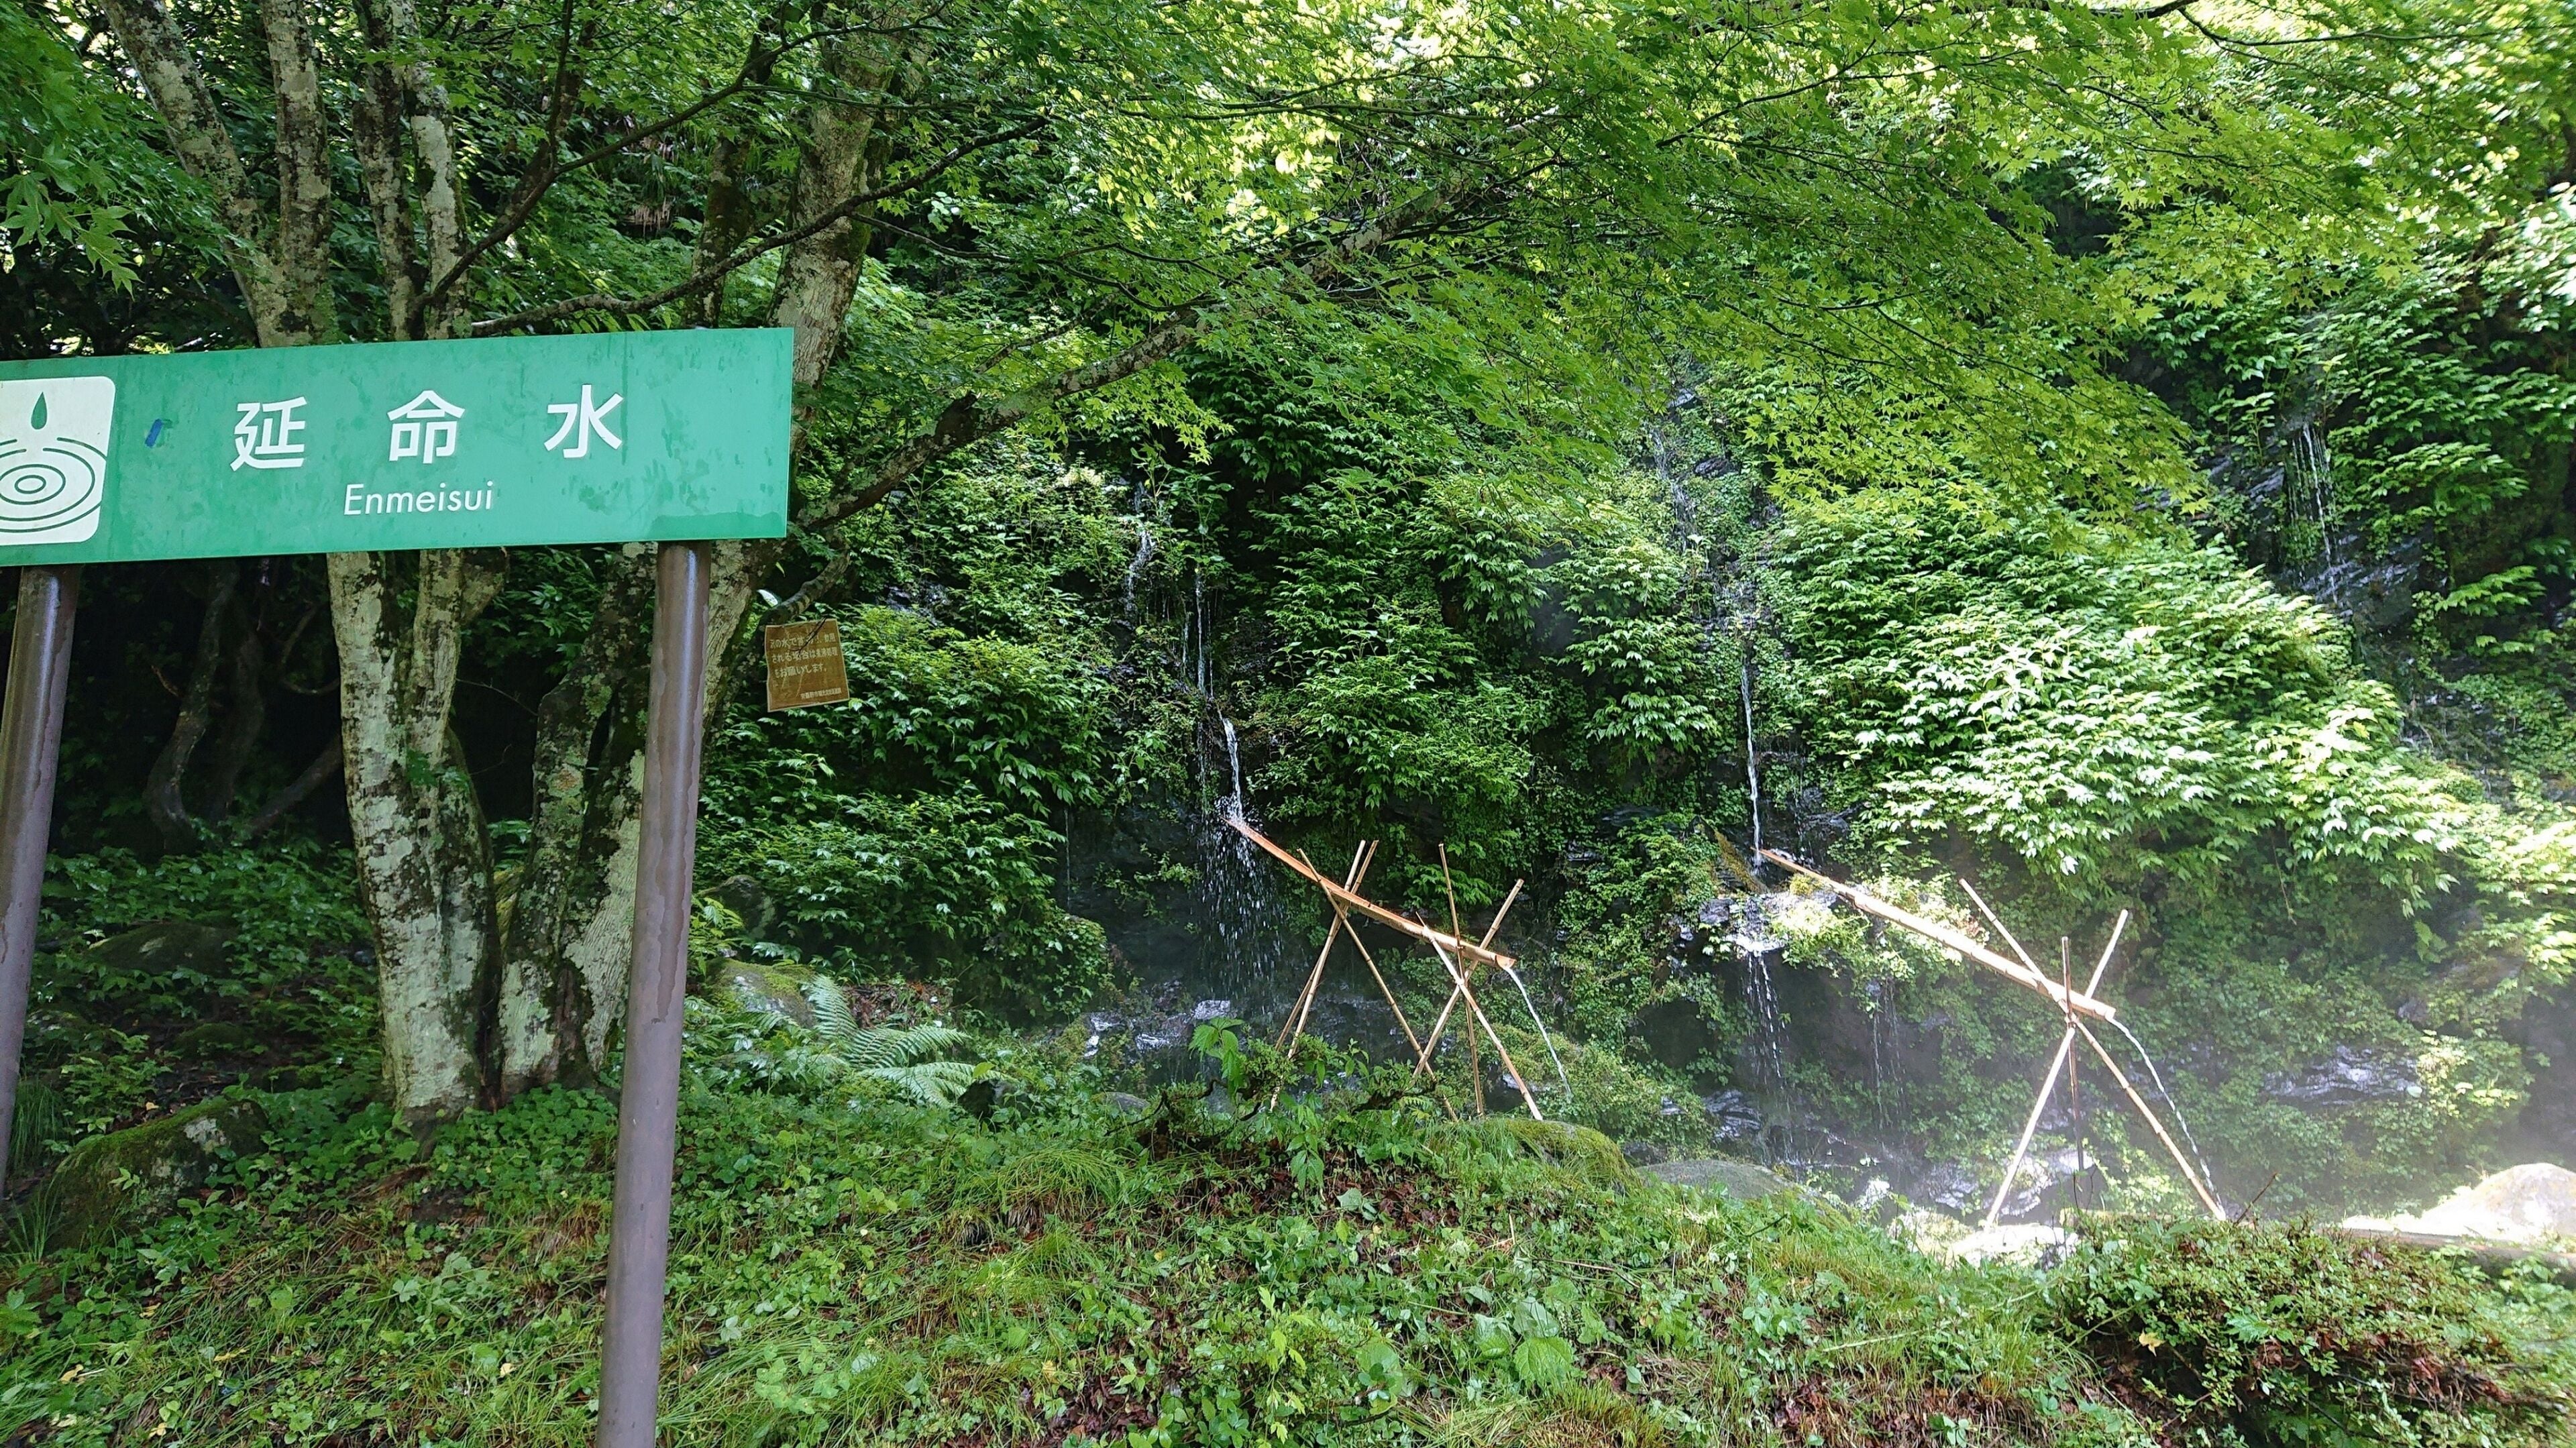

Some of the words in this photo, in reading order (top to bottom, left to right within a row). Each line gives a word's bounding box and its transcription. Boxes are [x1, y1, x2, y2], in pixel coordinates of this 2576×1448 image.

[230, 384, 624, 471] 延命水
[344, 481, 493, 516] Enmeisui
